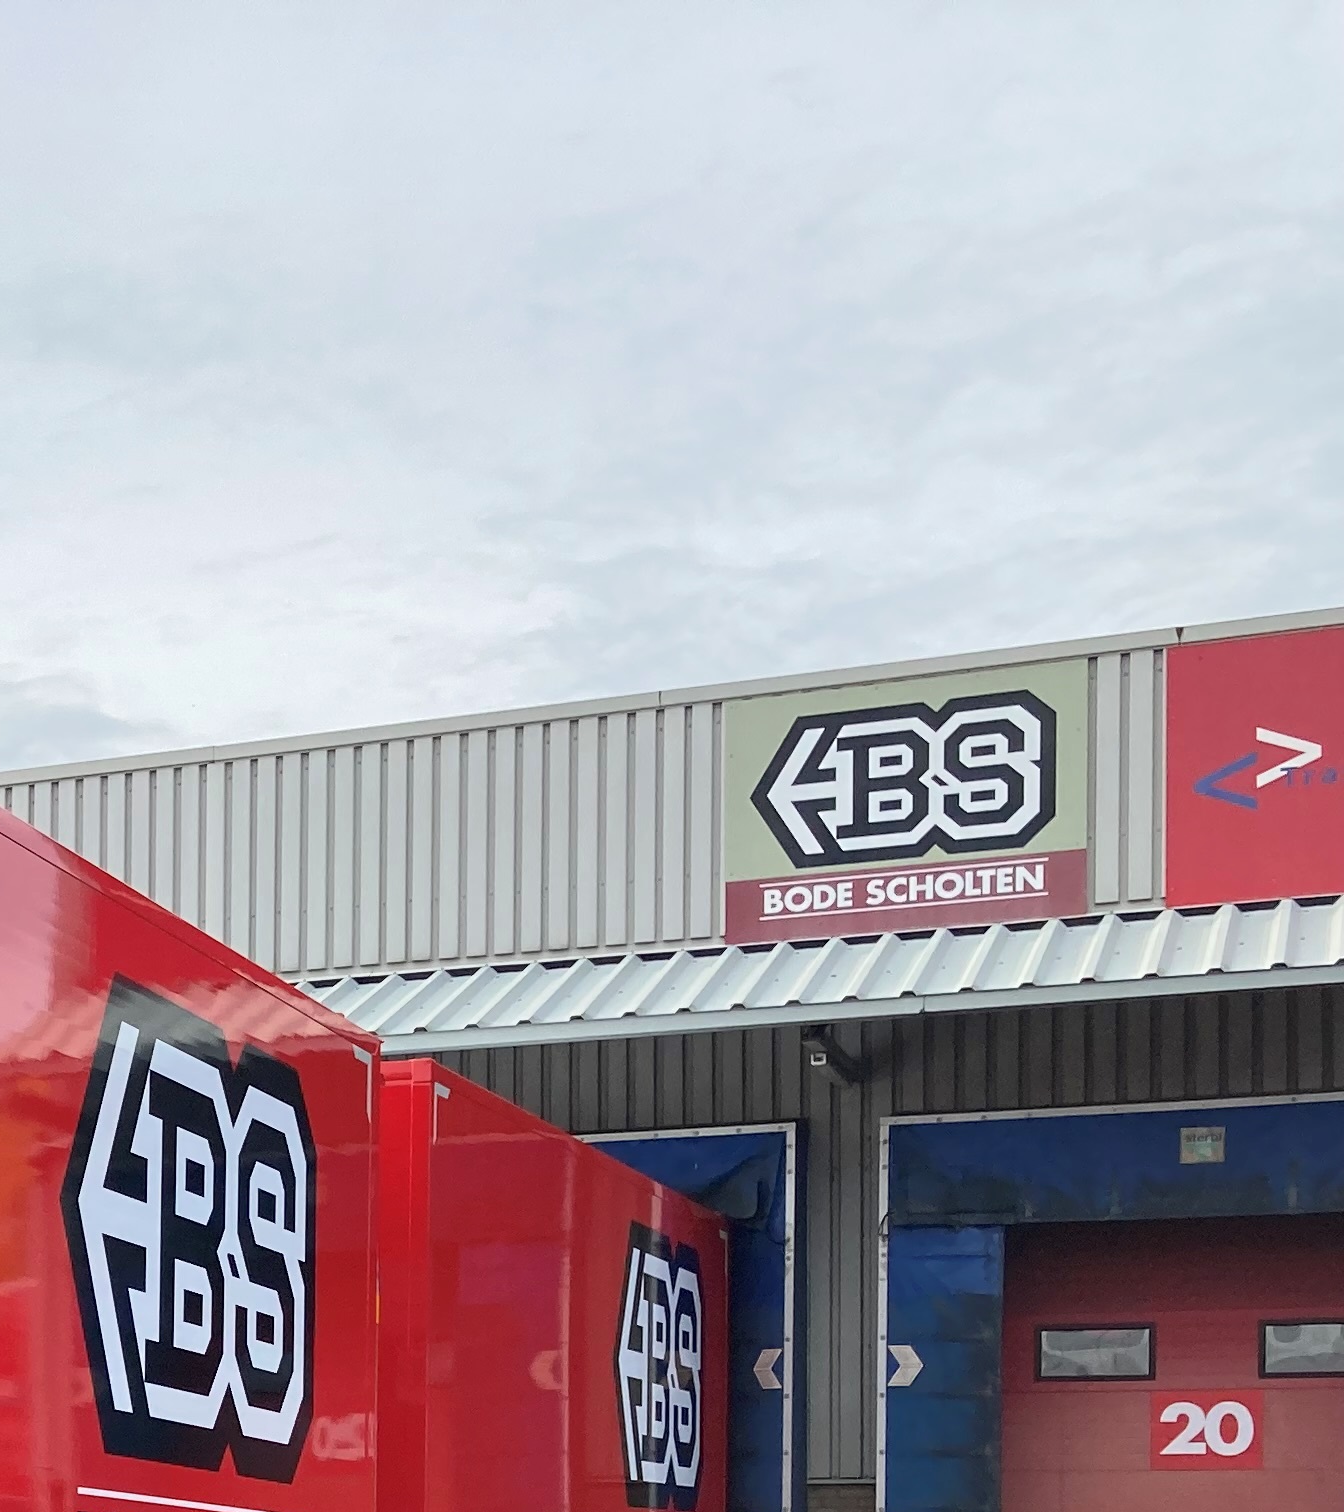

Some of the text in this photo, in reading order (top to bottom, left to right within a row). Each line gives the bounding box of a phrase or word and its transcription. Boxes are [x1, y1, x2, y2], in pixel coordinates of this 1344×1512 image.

[763, 864, 1045, 915] BODE SCHOLTEN
[1159, 1401, 1255, 1456] 20
